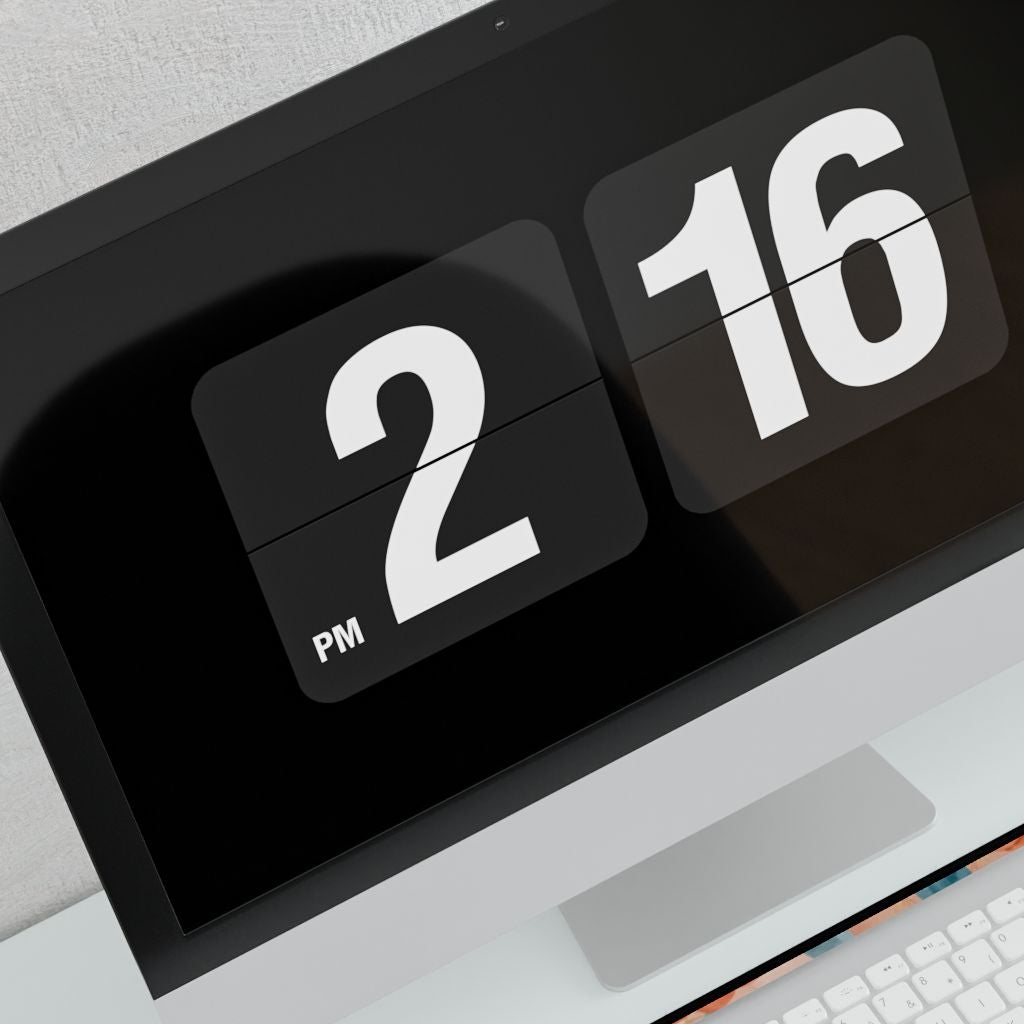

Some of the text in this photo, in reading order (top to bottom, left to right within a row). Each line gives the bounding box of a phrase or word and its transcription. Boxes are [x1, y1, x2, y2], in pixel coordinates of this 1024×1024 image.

[325, 107, 948, 625] 2 16
[312, 616, 365, 664] PM
[956, 954, 966, 965] 9
[918, 976, 928, 986] 8
[878, 997, 886, 1007] 7
